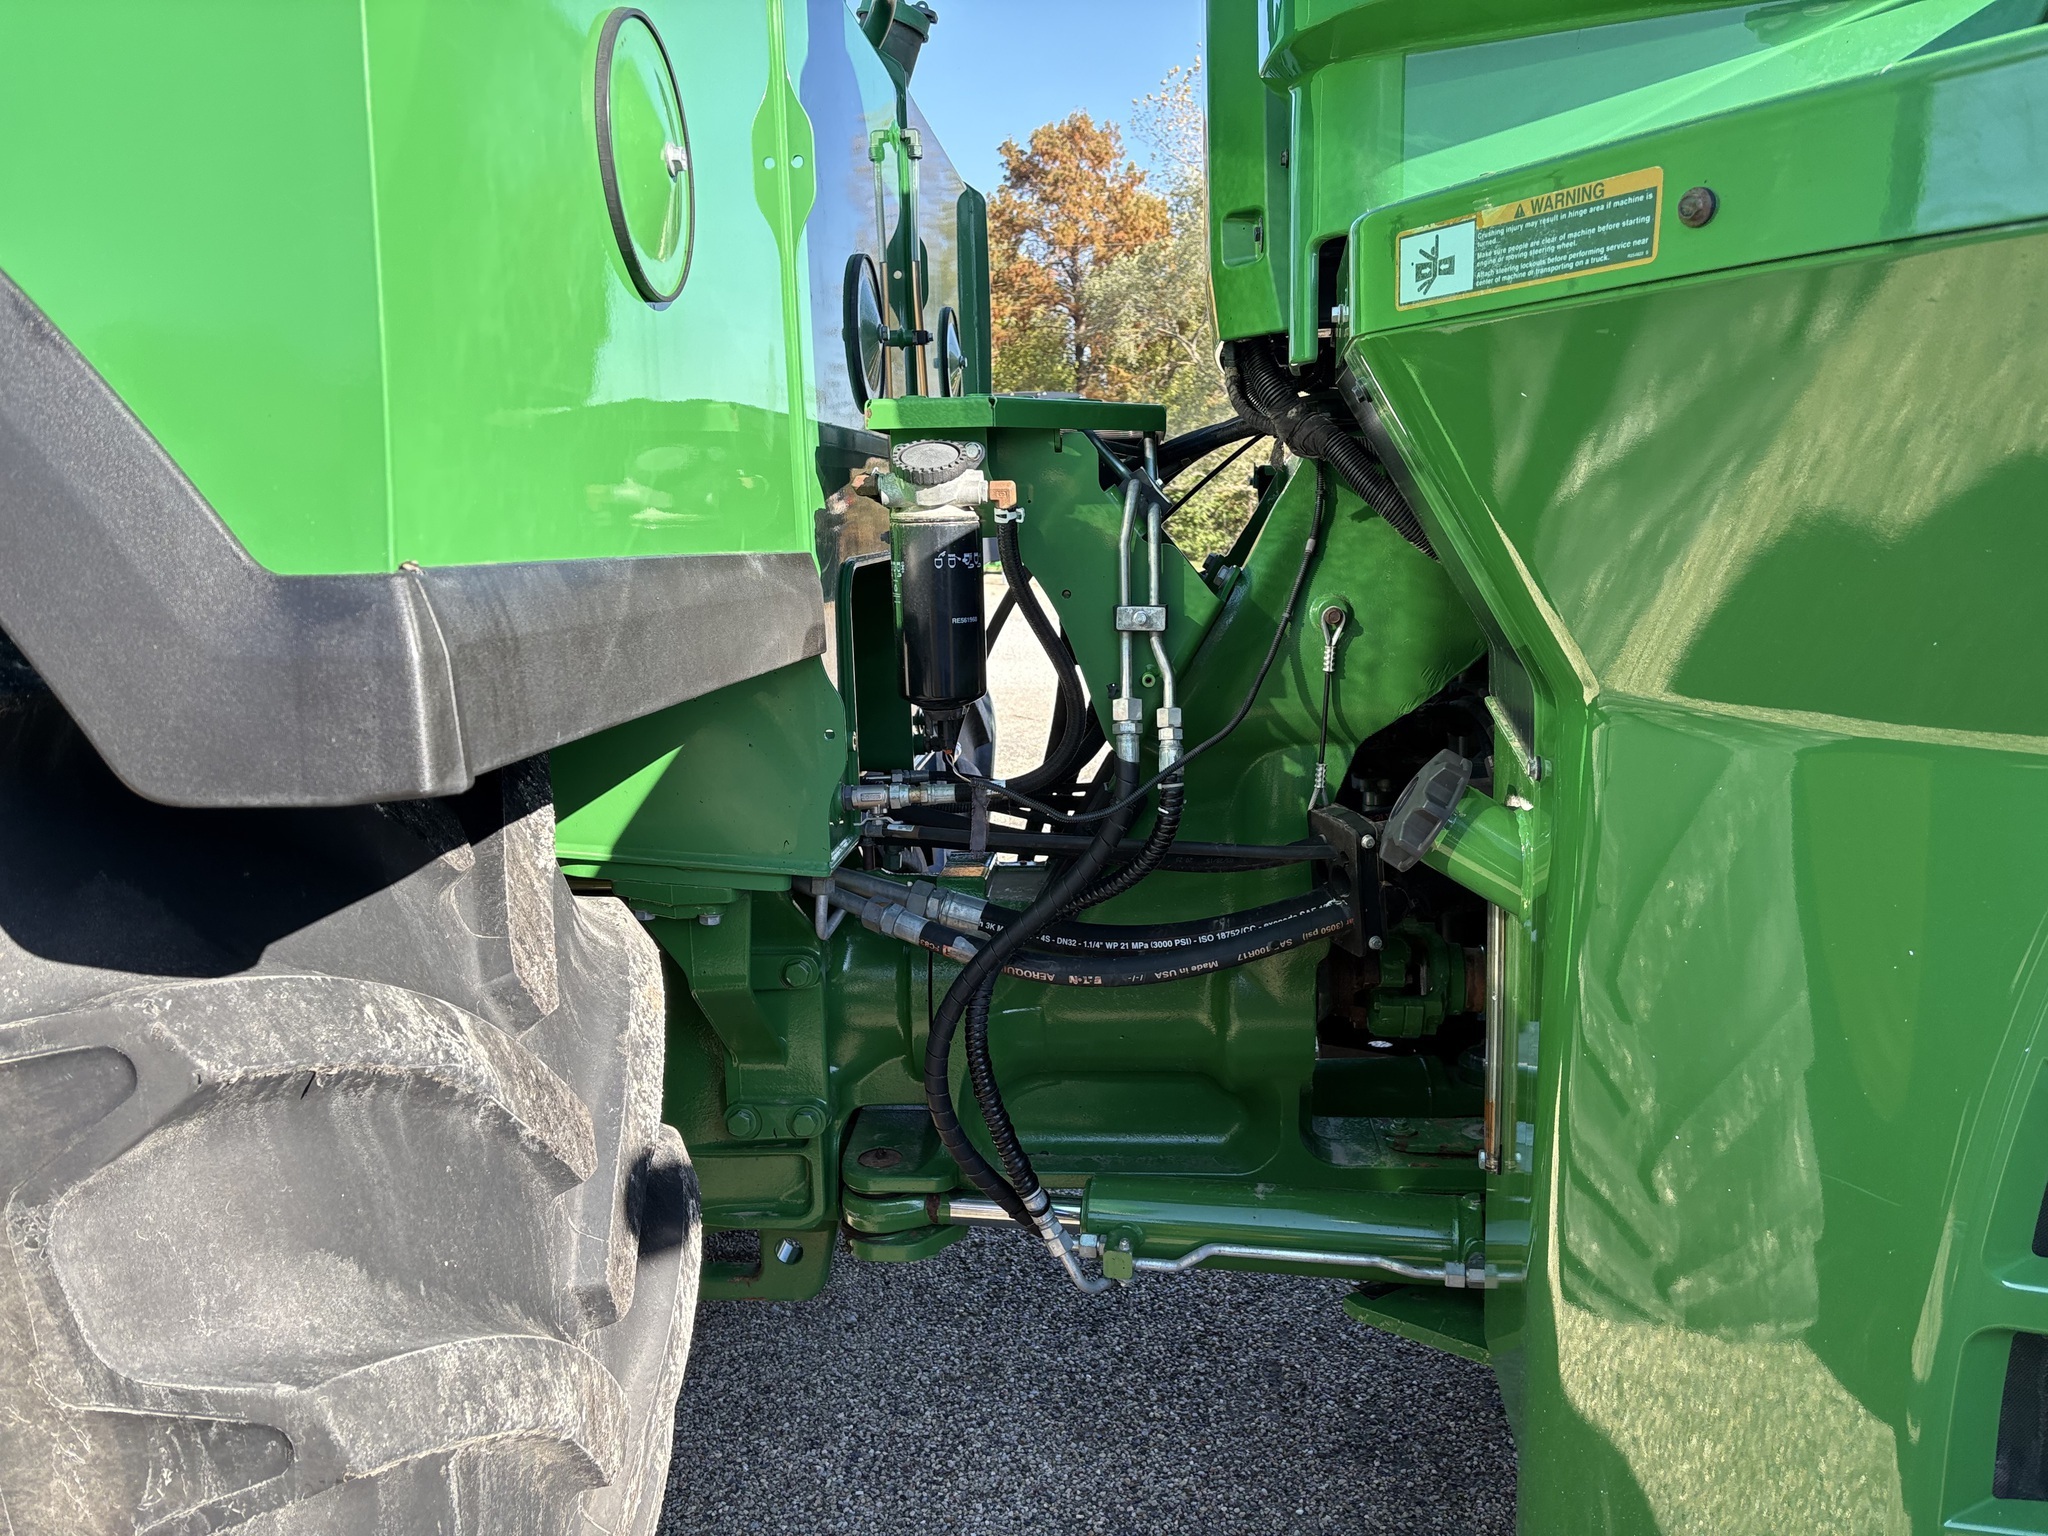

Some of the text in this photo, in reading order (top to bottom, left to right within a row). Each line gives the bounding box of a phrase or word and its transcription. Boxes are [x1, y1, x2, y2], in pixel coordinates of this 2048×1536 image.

[1531, 182, 1605, 214] WARNING
[1477, 192, 1653, 240] Crushing injury may result in hinge area if machine is
[1477, 215, 1651, 260] Make sure people are clear of machine before starting
[1476, 240, 1577, 269] engine or moving steering wheel.
[1476, 237, 1649, 279] Attach steering lockouts before performing service near
[1475, 276, 1494, 287] center
[1494, 274, 1502, 284] of
[1502, 271, 1527, 283] machine
[1527, 268, 1535, 277] or
[1535, 260, 1574, 276] transporting
[1574, 259, 1584, 268] on
[1591, 253, 1609, 264] truck.
[985, 921, 997, 931] 3K
[1302, 928, 1319, 941] psi)
[1320, 920, 1344, 935] (3050
[1040, 934, 1051, 943] 4S
[1056, 937, 1077, 947] DN32
[1083, 940, 1103, 949] 1.1/4"
[1105, 941, 1119, 950] WP
[1120, 941, 1130, 950] 21
[1131, 941, 1149, 950] MPa
[1150, 939, 1173, 949] (3000
[1174, 937, 1192, 947] PSI)
[1199, 934, 1215, 944] ISO
[1237, 938, 1293, 961] SA 100R17
[1002, 966, 1056, 982] AEROQUI
[1154, 959, 1219, 980] Made in USA
